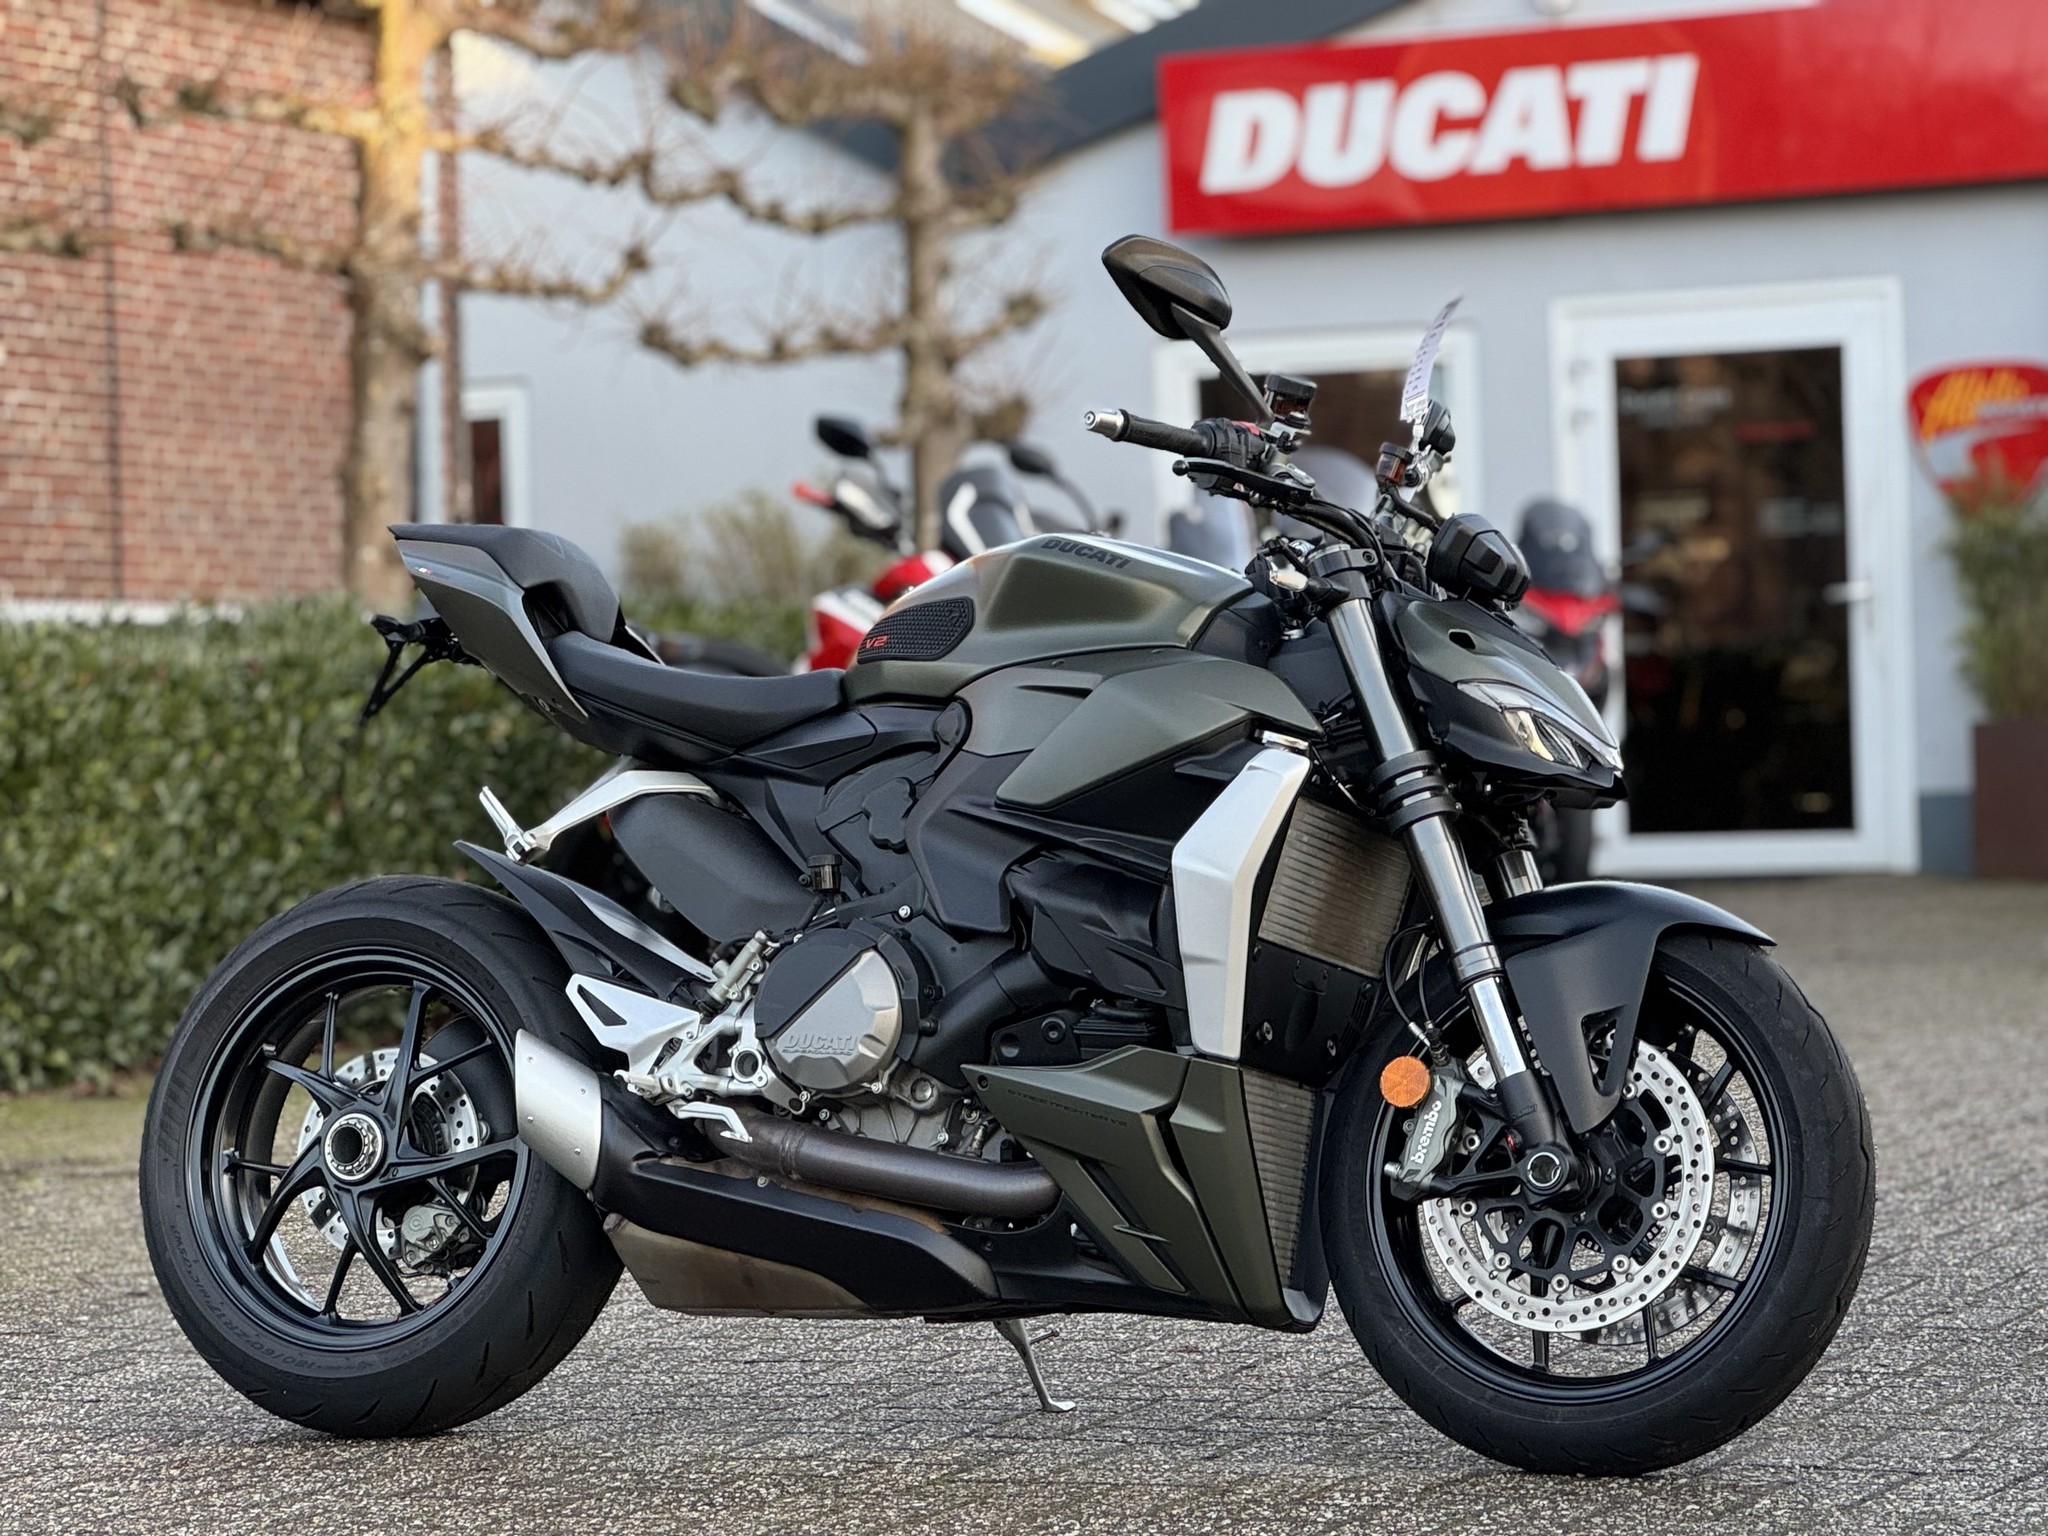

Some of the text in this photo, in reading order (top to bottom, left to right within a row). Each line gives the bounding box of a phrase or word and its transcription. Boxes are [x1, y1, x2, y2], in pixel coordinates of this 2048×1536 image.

[1199, 53, 1698, 195] DUCATI
[1041, 538, 1131, 569] DUCATI
[866, 635, 888, 649] V2
[784, 1033, 858, 1051] DUCATI
[1411, 1100, 1442, 1164] brembo
